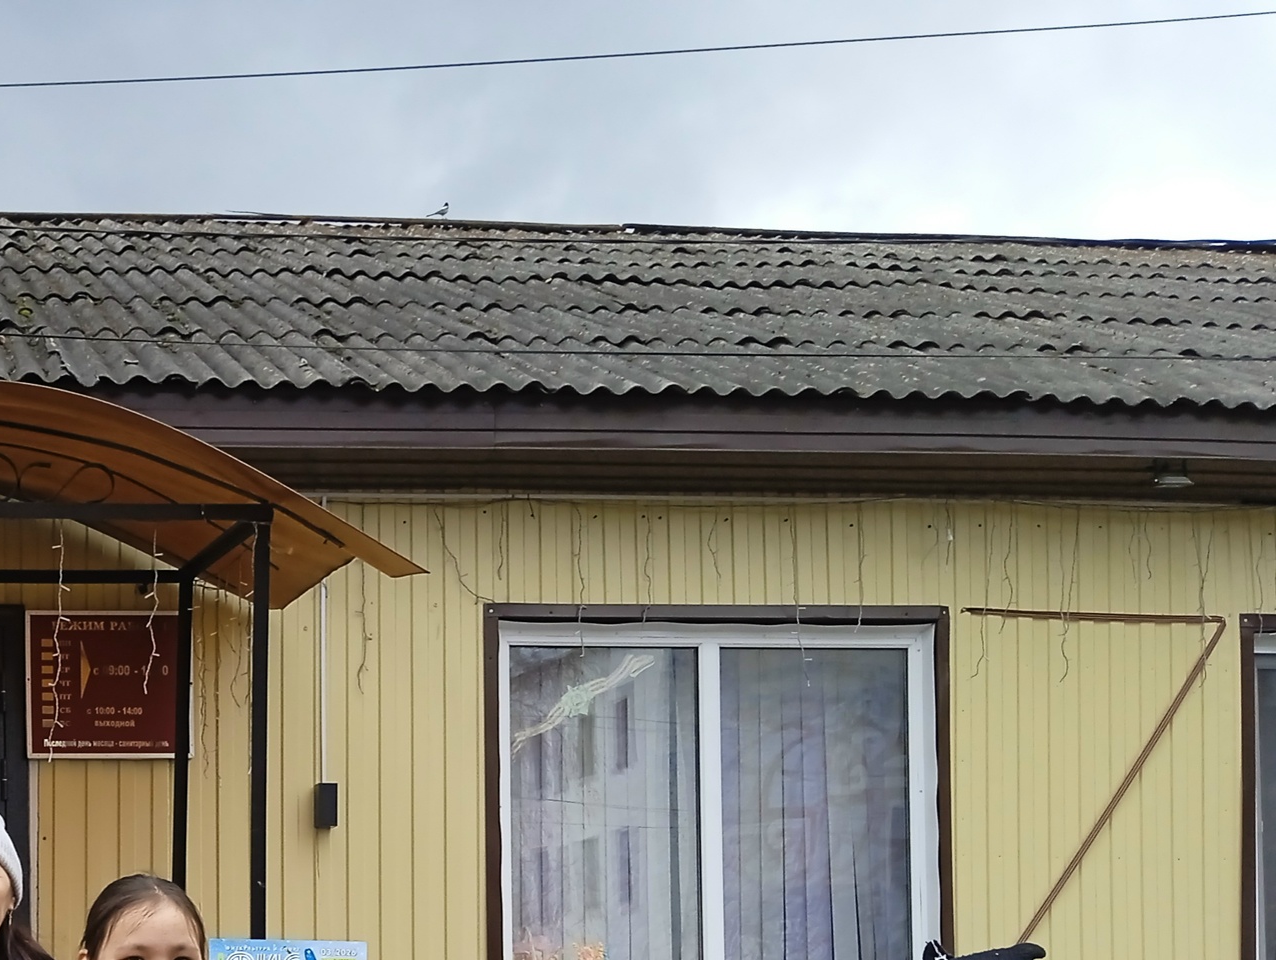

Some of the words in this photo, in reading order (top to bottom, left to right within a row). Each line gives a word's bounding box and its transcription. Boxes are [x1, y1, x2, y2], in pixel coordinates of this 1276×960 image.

[95, 707, 115, 715] 10:00
[124, 707, 143, 715] 14:00
[95, 720, 135, 728] выходной
